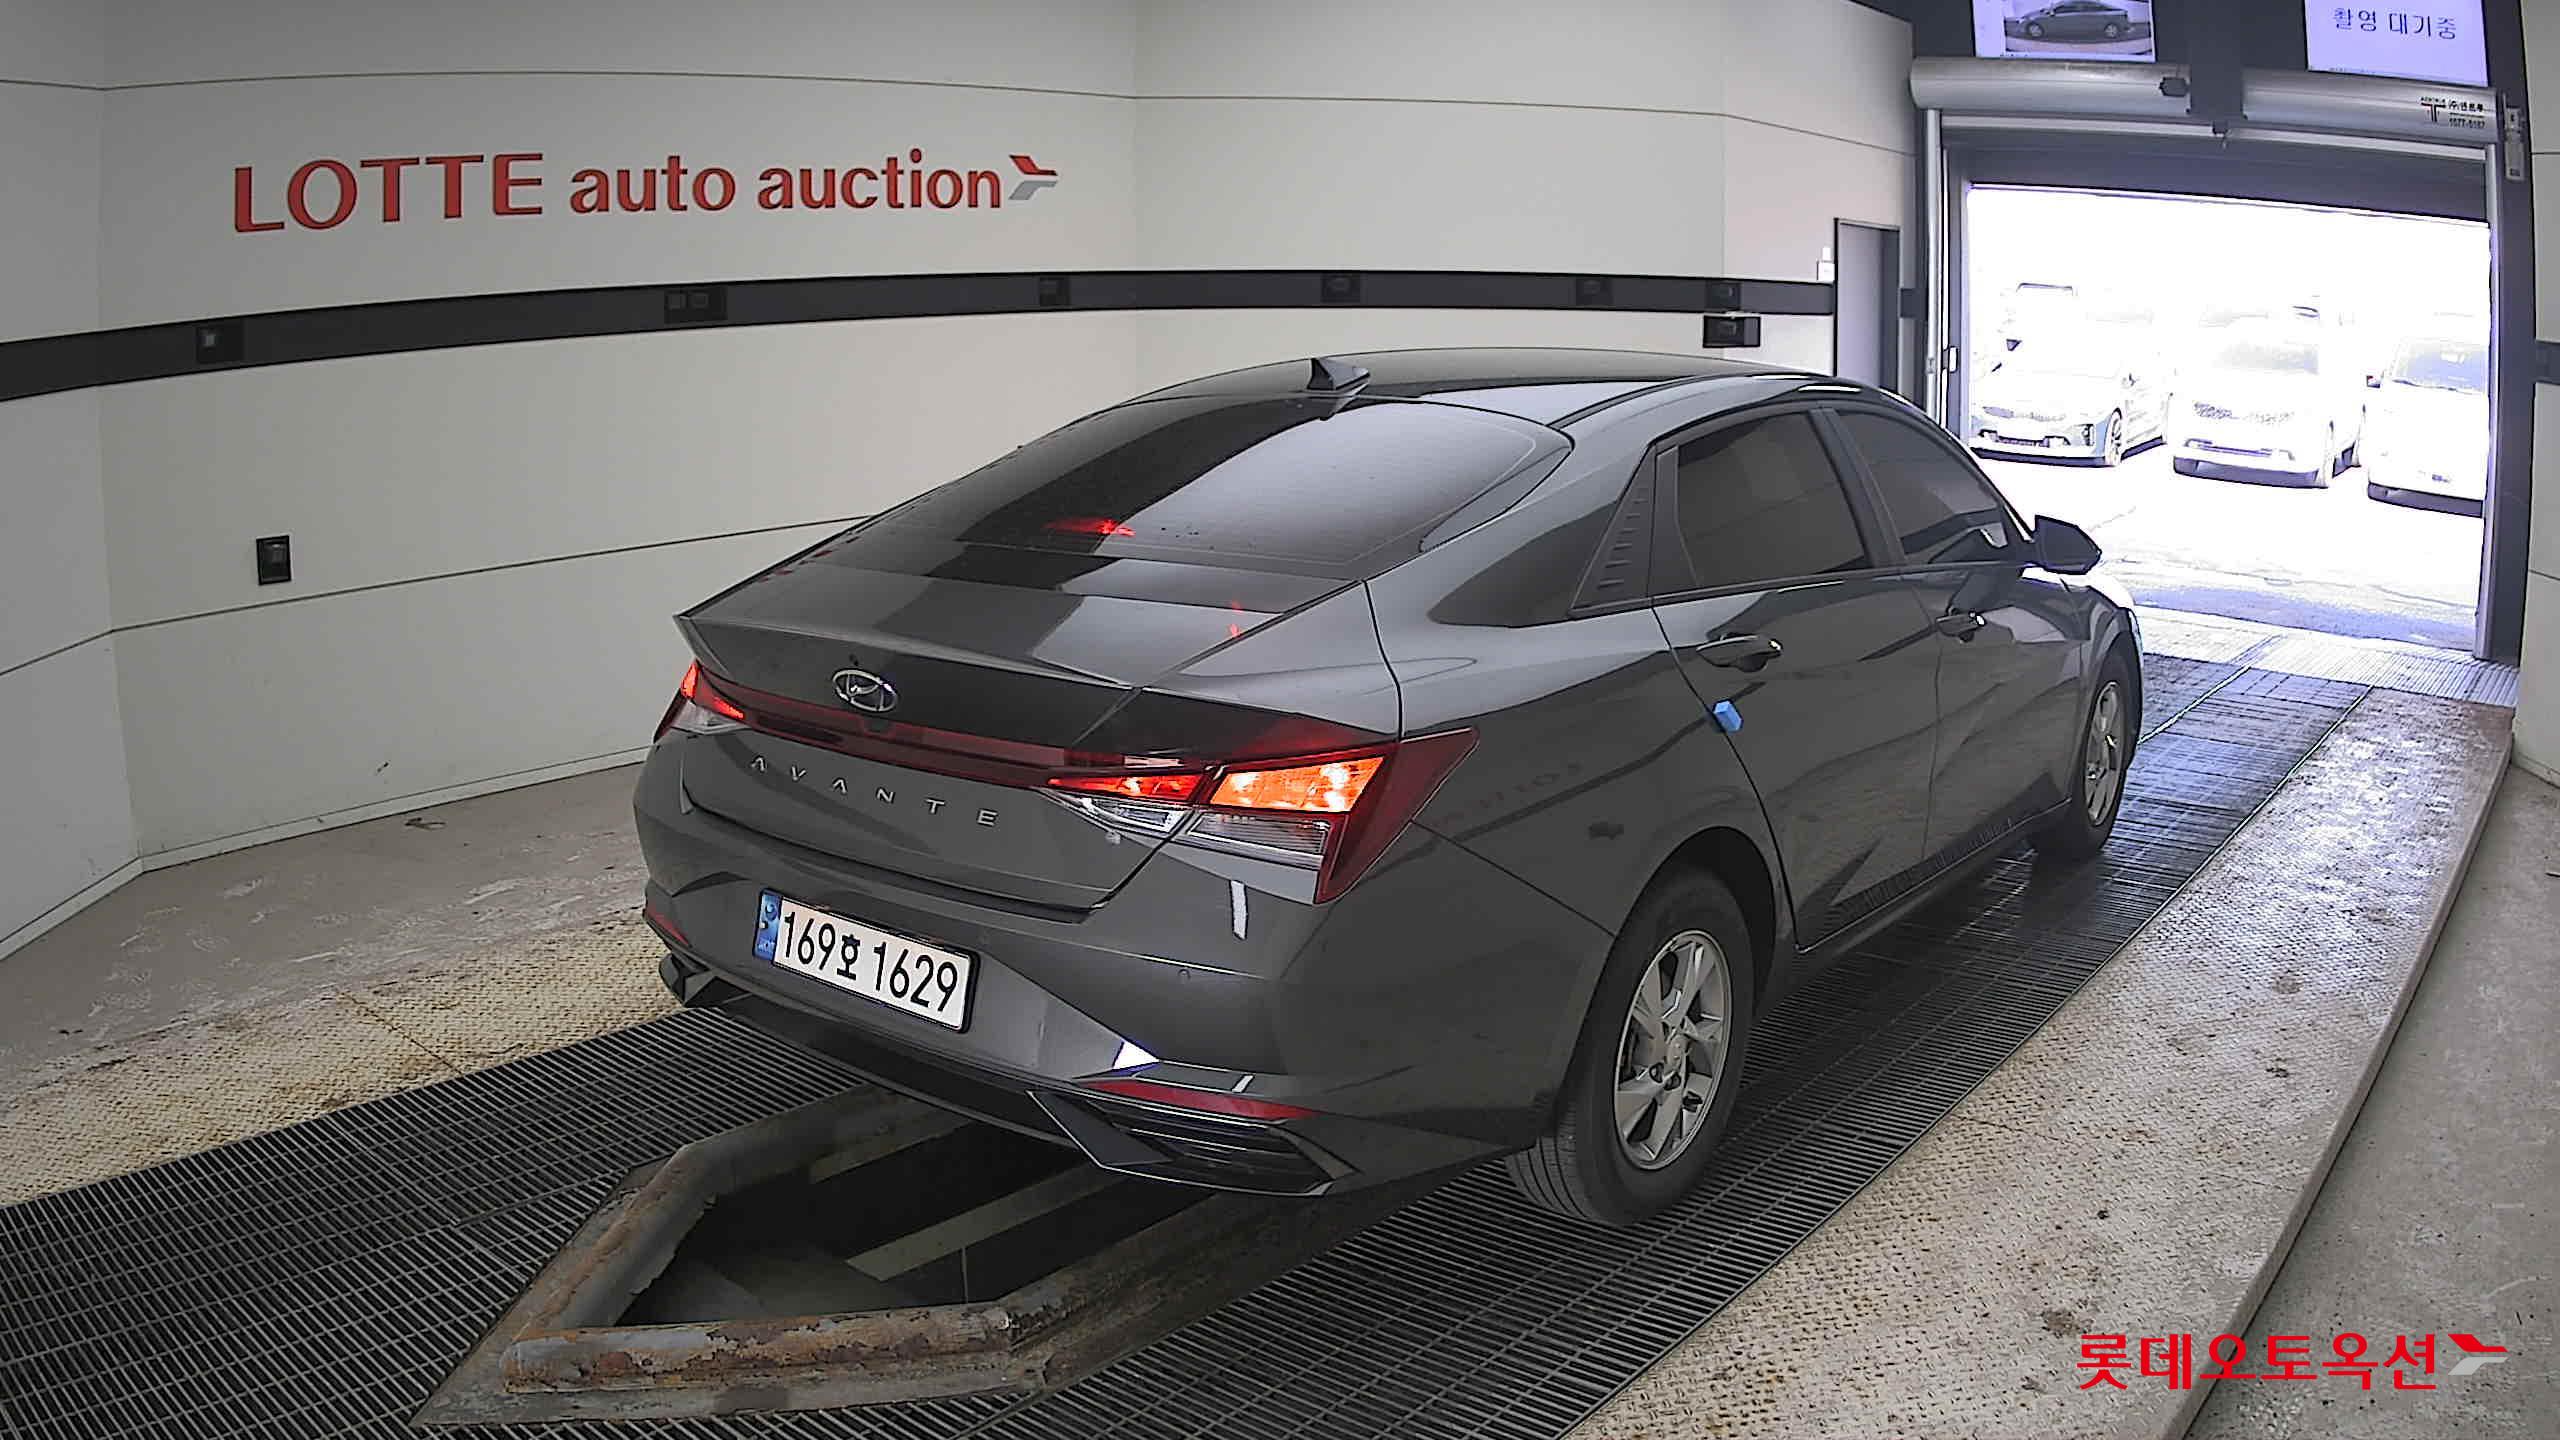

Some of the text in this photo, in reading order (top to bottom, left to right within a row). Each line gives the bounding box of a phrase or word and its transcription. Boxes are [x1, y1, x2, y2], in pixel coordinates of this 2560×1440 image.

[2334, 8, 2457, 40] 촬영 대기중
[236, 149, 1002, 232] LOTTE auto auction
[750, 755, 999, 827] AVANTE
[784, 911, 958, 1012] 169호 1629
